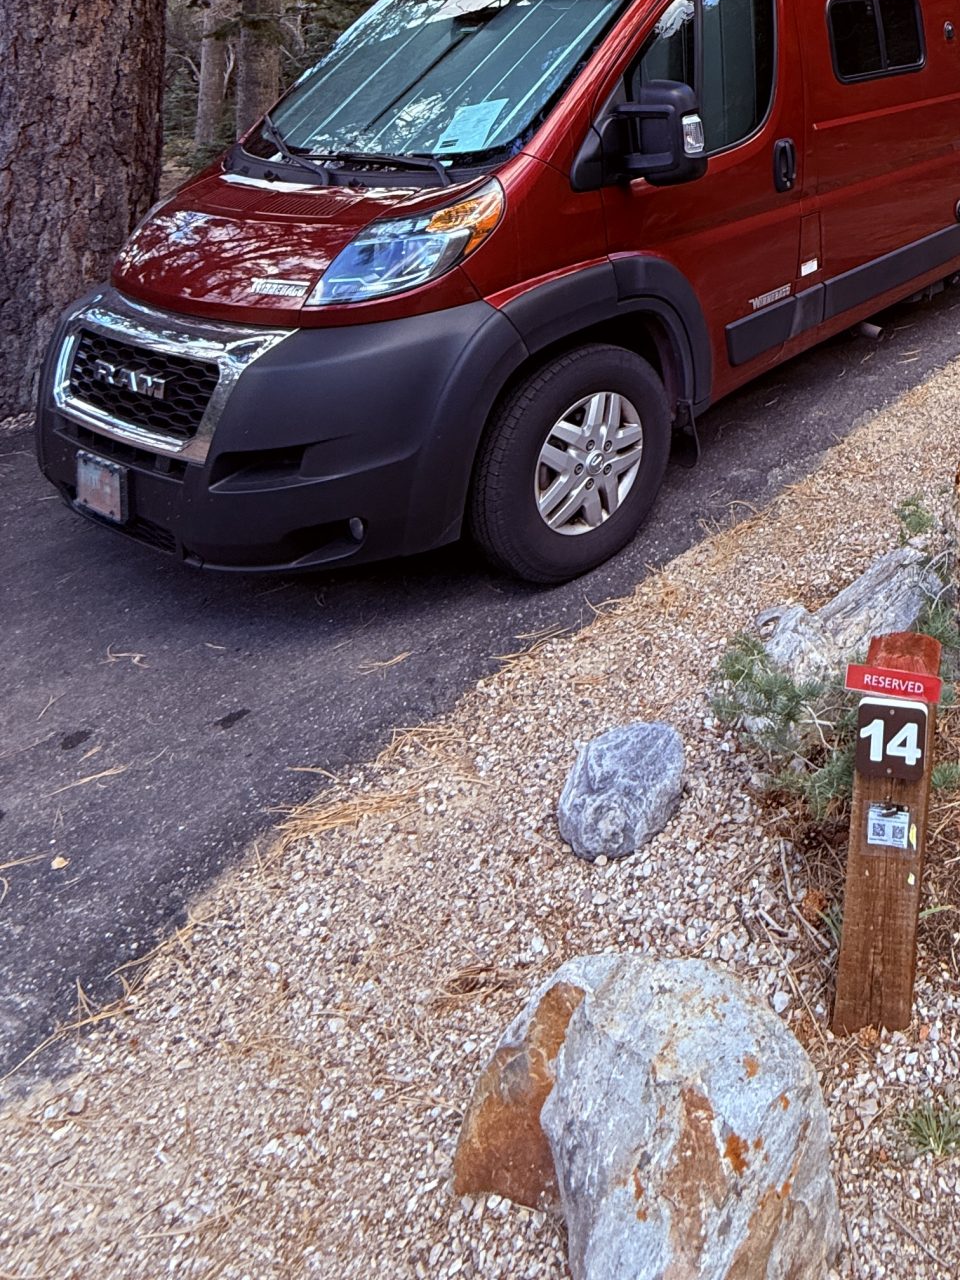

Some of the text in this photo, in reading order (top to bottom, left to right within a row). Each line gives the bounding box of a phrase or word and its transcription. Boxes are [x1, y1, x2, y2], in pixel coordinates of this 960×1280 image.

[94, 359, 165, 400] RAM
[863, 673, 924, 694] RESERVED
[860, 718, 922, 766] 14
